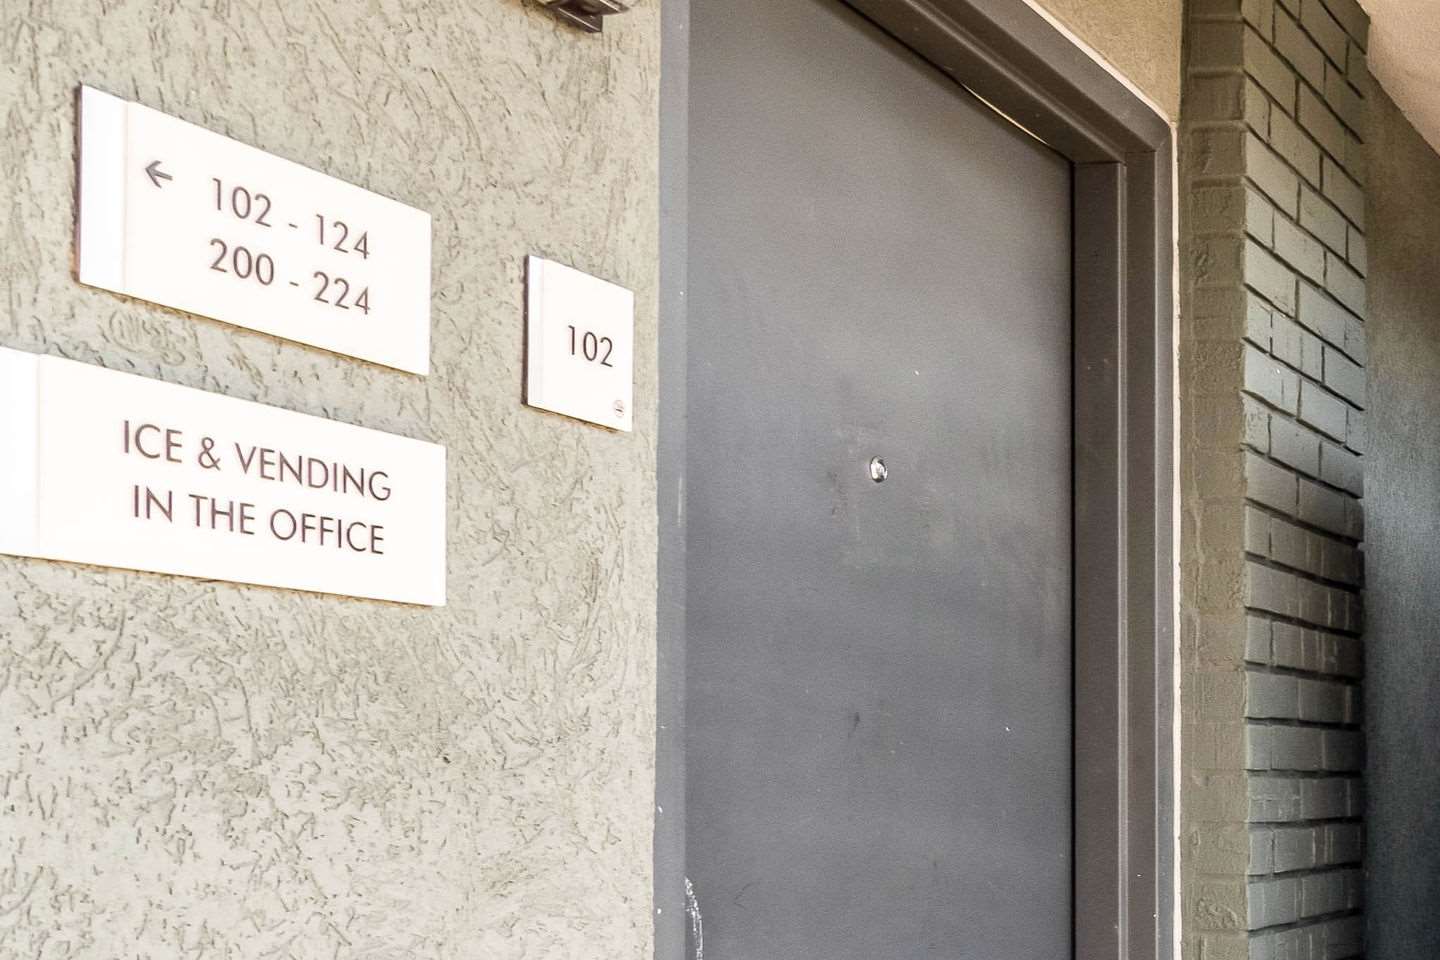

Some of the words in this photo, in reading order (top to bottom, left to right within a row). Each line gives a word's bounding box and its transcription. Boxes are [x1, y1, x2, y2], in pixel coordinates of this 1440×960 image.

[212, 177, 272, 228] 102
[315, 213, 370, 260] 124
[209, 238, 275, 286] 200
[313, 270, 371, 316] 224
[567, 324, 614, 368] 102
[123, 419, 183, 464] ICE
[197, 436, 221, 471] &
[234, 442, 392, 502] VENDING
[133, 484, 173, 523] IN
[188, 493, 256, 536] THE
[269, 508, 385, 555] OFFICE
